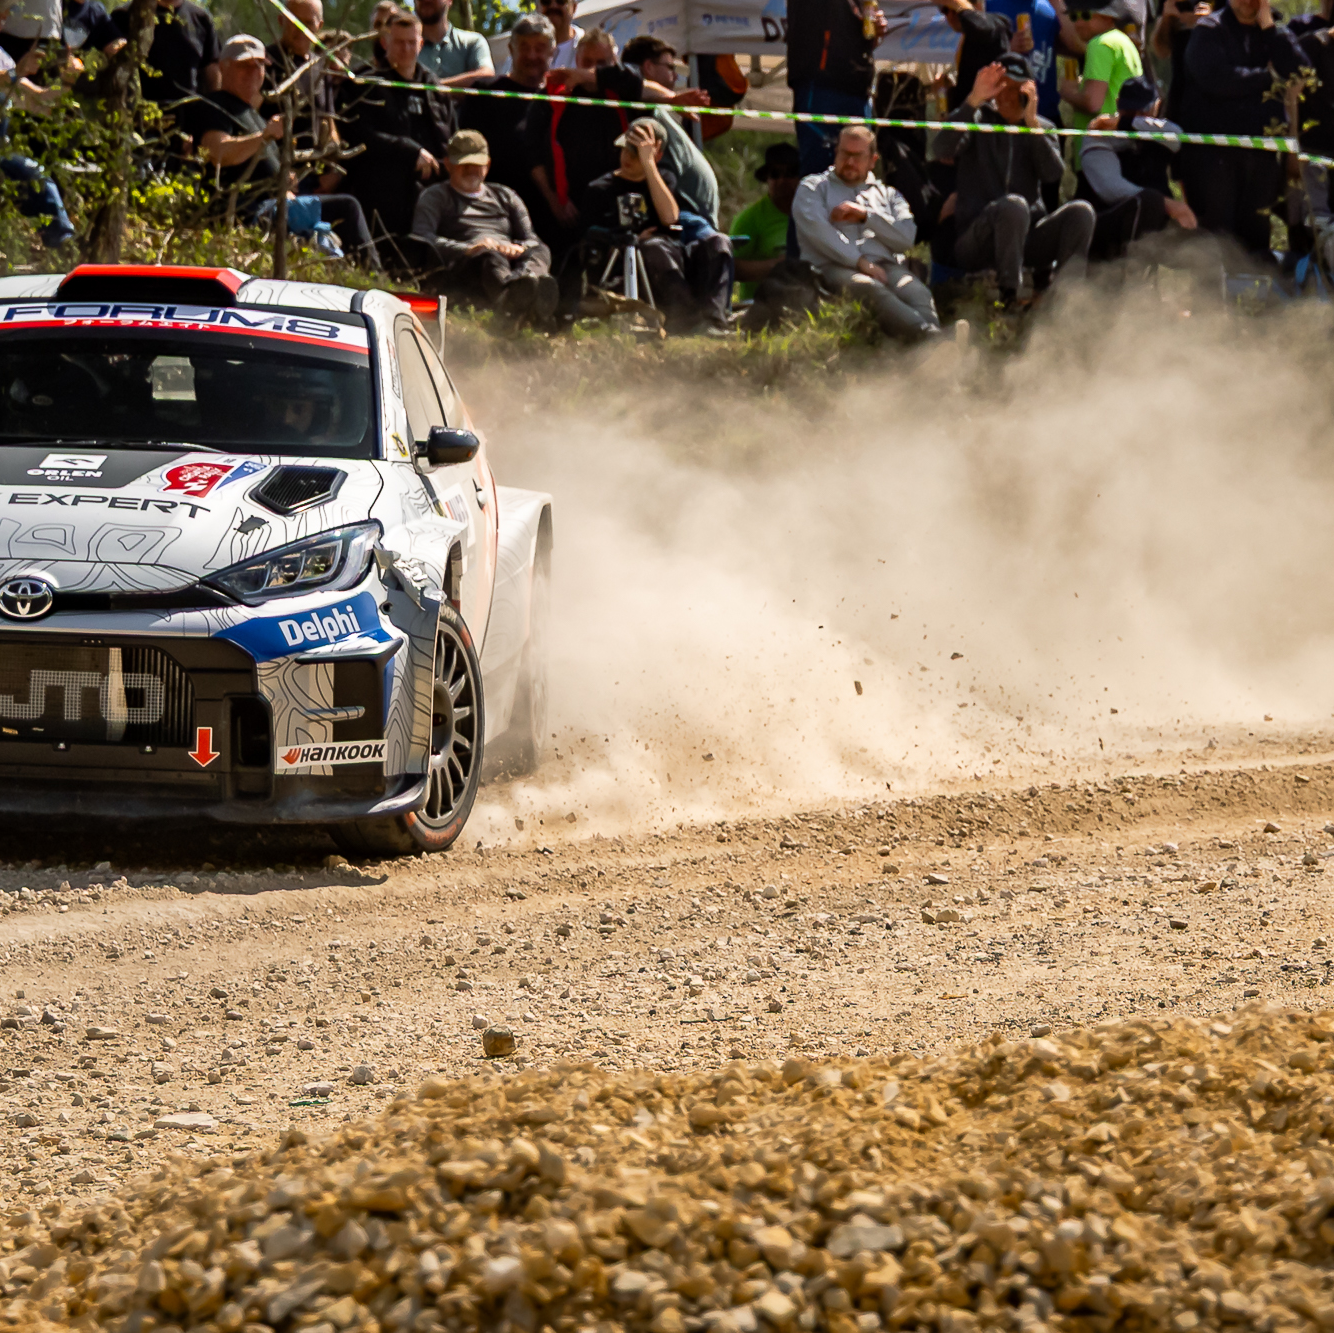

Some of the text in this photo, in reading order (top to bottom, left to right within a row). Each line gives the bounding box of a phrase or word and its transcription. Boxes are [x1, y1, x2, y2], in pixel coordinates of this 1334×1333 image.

[3, 303, 341, 339] FORUM8
[26, 468, 104, 478] ORLEN
[8, 492, 212, 519] EXPERT
[278, 604, 361, 647] Delphi
